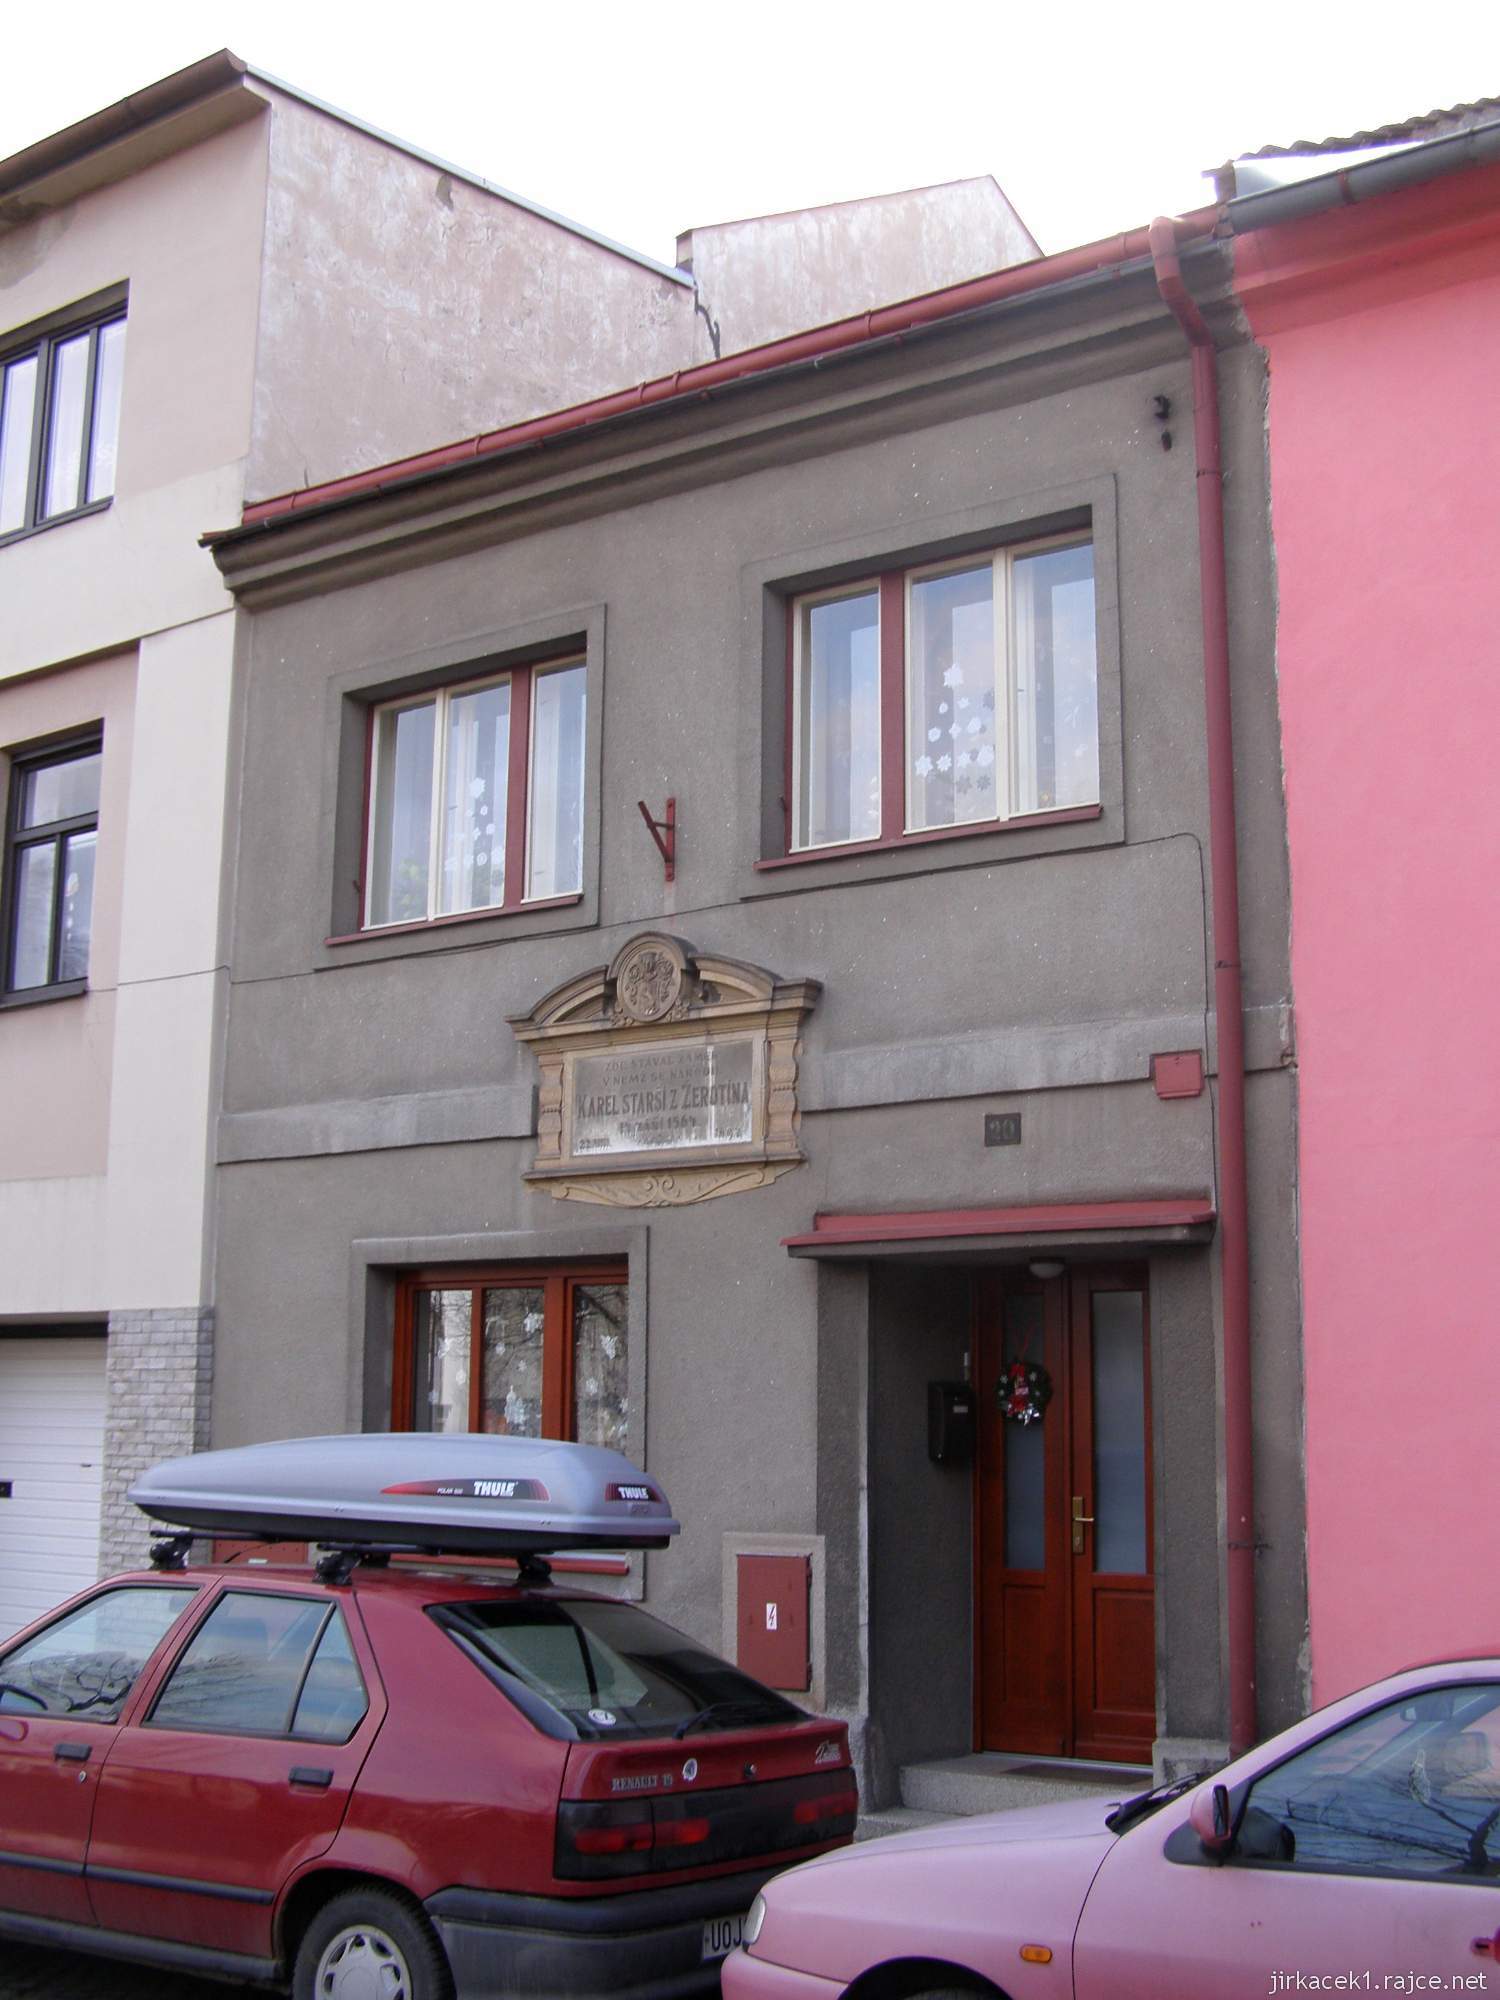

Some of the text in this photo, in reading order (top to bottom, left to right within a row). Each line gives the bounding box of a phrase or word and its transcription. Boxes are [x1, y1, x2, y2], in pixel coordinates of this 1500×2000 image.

[577, 1094, 619, 1119] KAREL
[474, 1481, 515, 1497] THULE
[618, 1486, 649, 1499] THULE
[611, 1774, 657, 1791] RENAULT
